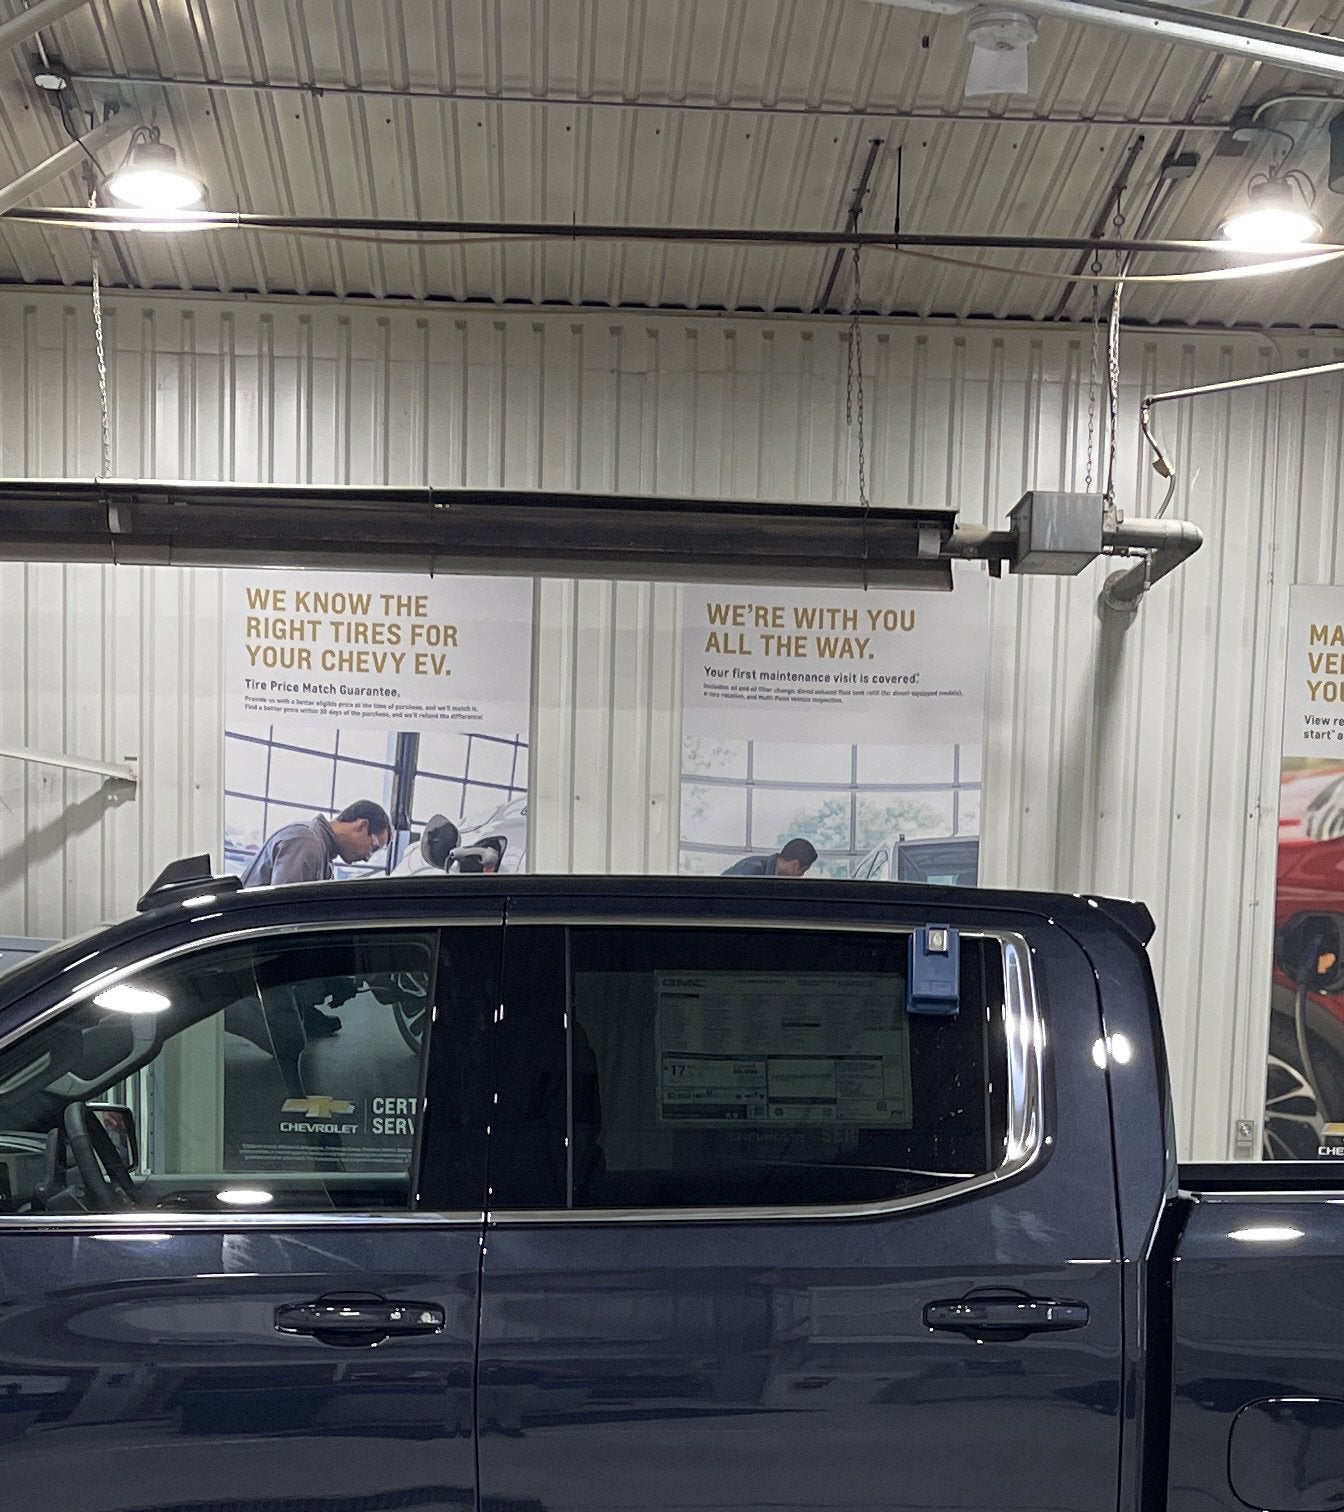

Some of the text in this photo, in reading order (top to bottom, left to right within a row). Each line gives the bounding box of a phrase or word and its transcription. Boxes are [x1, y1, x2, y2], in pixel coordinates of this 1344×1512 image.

[246, 588, 428, 617] WE KNOW THE
[246, 616, 458, 647] RIGHT TIRES FOR
[706, 603, 915, 632] WE'RE WITH YOU
[246, 644, 451, 676] YOUR CHEVY EV.
[705, 632, 874, 660] ALL THE WAY.
[245, 678, 267, 691] Tire
[270, 680, 299, 693] Price
[302, 682, 336, 695] Match
[704, 666, 728, 678] Your
[732, 668, 756, 680] first
[760, 670, 830, 683] maintenance
[833, 672, 856, 683] visit
[860, 674, 868, 684] is
[1304, 715, 1330, 726] View
[280, 1122, 358, 1135] CHEVROLET
